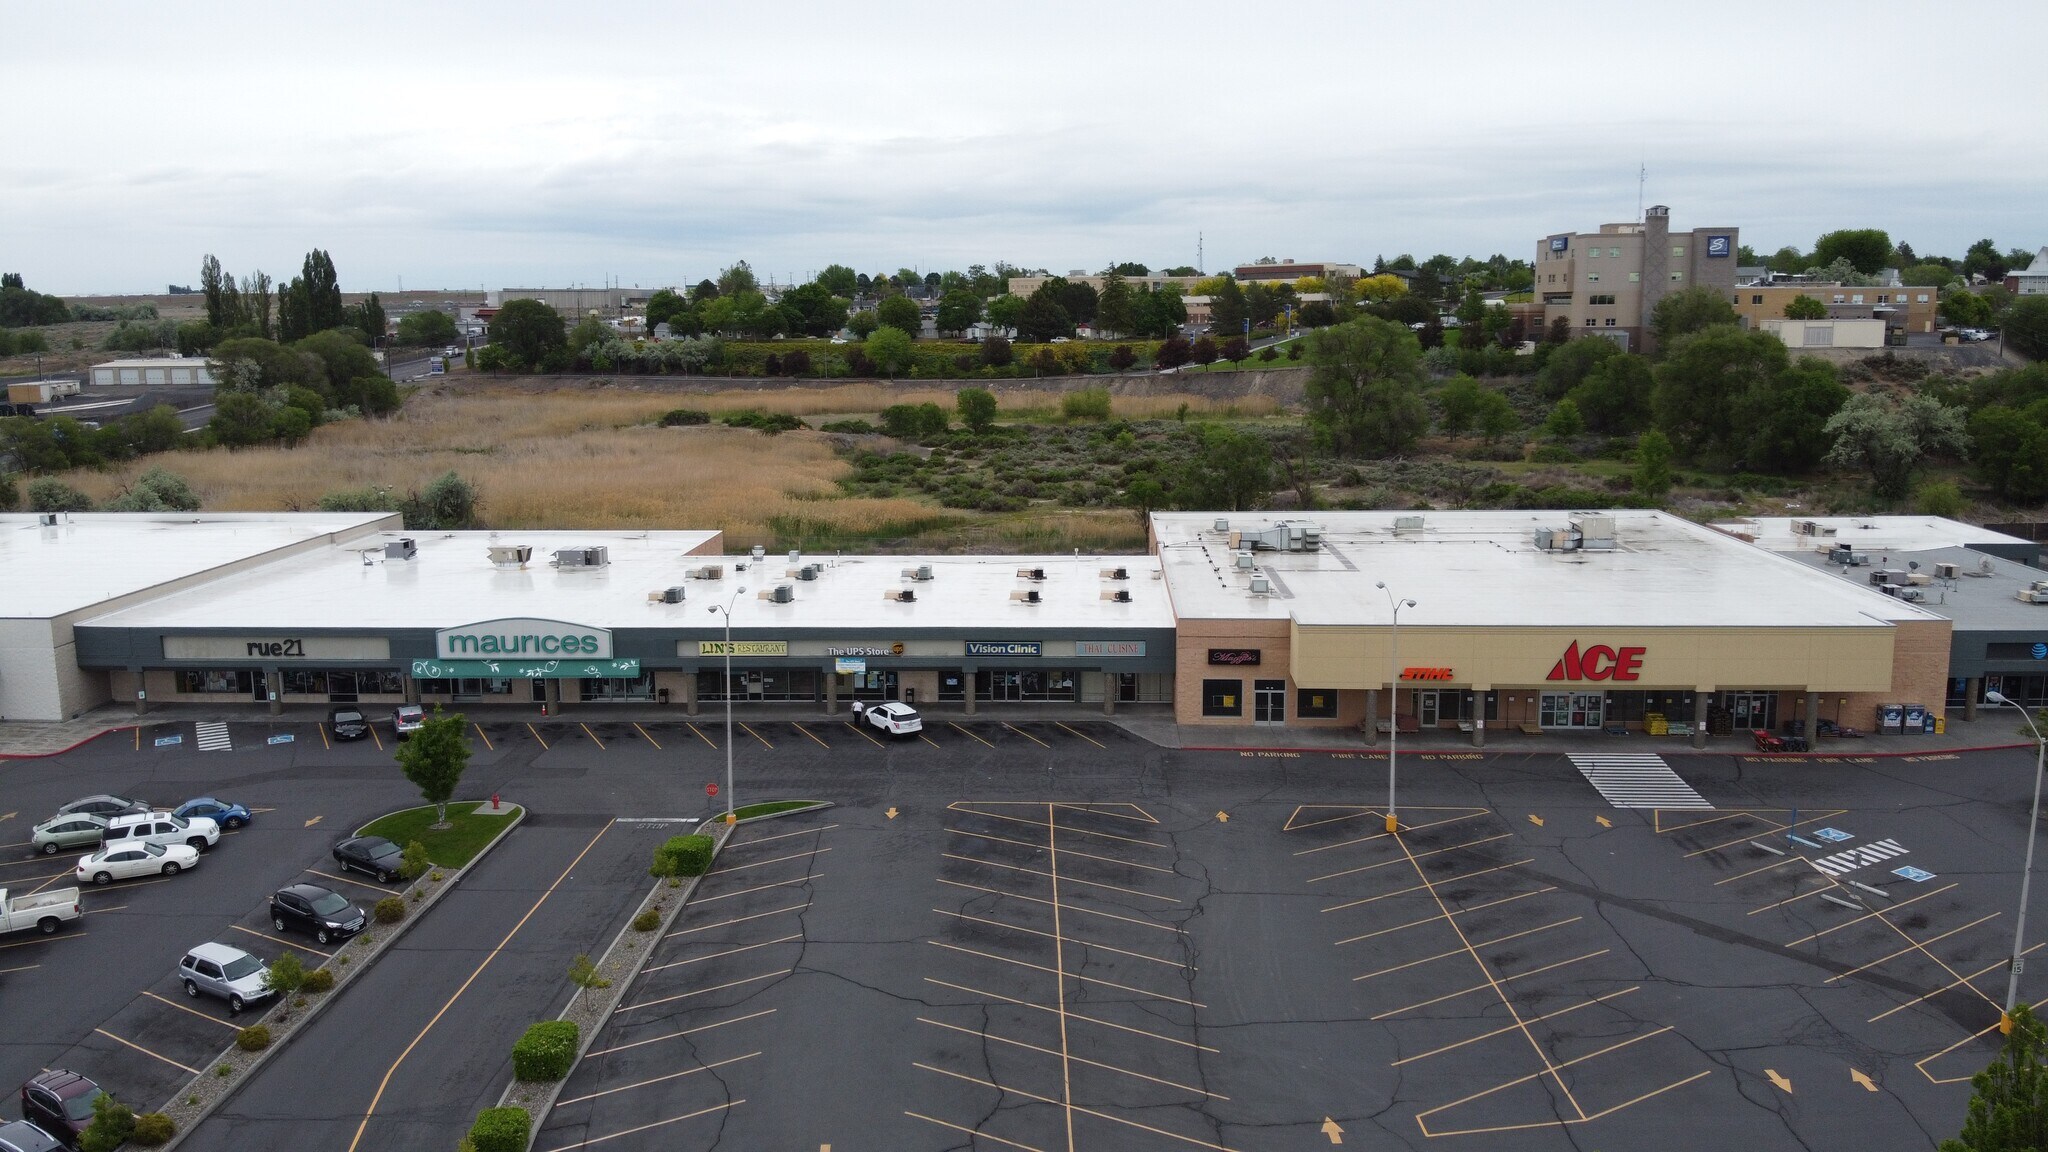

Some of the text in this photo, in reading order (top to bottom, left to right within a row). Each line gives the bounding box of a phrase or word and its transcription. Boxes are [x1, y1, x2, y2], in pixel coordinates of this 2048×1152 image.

[246, 638, 306, 657] rue21
[448, 634, 599, 654] maurices
[702, 642, 786, 654] LIN'S RESTAURANT
[969, 643, 1038, 654] Vision Clinic
[1084, 643, 1139, 653] THAI CUISINE
[828, 647, 890, 656] The UPS Store
[1546, 639, 1647, 681] ACE
[1401, 667, 1454, 681] STIHL
